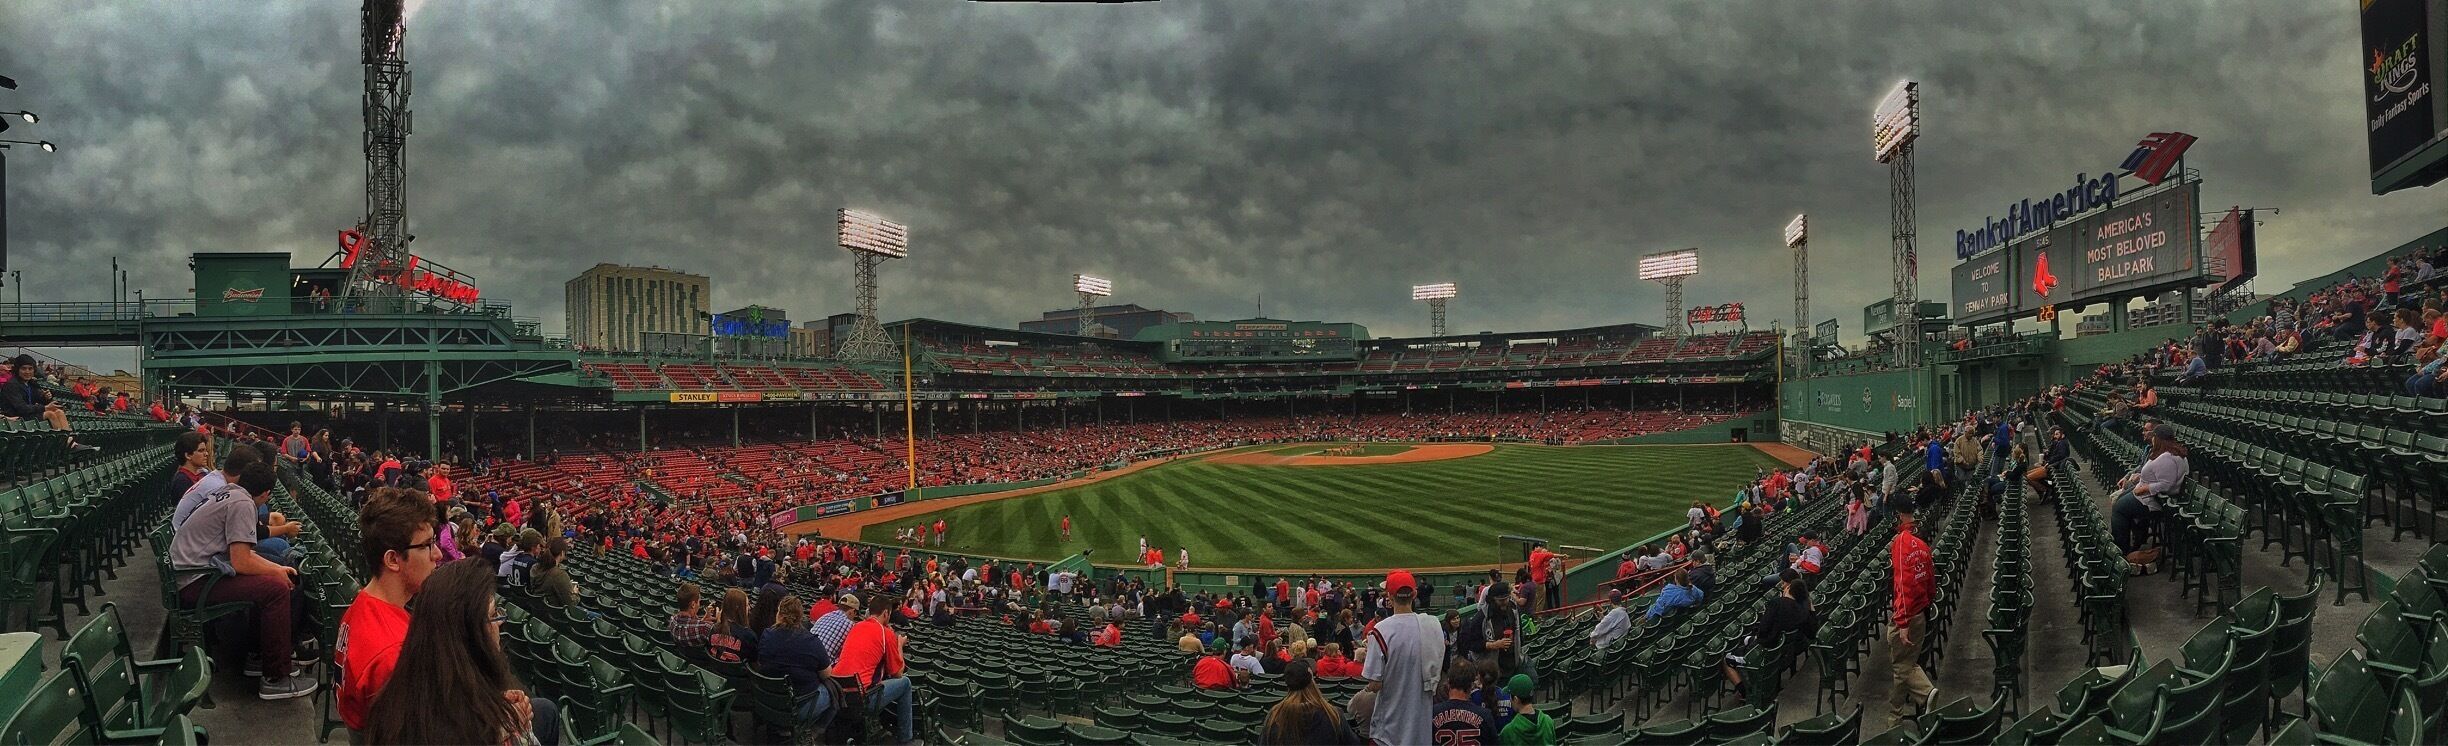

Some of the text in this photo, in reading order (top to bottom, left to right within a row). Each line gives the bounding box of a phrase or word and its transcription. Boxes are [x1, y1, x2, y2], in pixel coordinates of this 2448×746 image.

[2374, 33, 2418, 84] DRAFT
[2379, 52, 2418, 93] KINGS
[2371, 82, 2430, 132] Daily Fantasy Sports
[1956, 172, 2119, 260] Bank of America
[2097, 212, 2152, 240] AMERICA'S
[2087, 231, 2166, 264] MOST BELOVED
[1971, 262, 2000, 281] WELCOME
[2098, 257, 2154, 282] BALLPARK
[1981, 282, 1989, 293] TO
[1991, 293, 2008, 307] PARK
[1897, 394, 1917, 411] Sapiet
[1432, 708, 1484, 729] VALENTINE
[1435, 729, 1481, 746] 25
